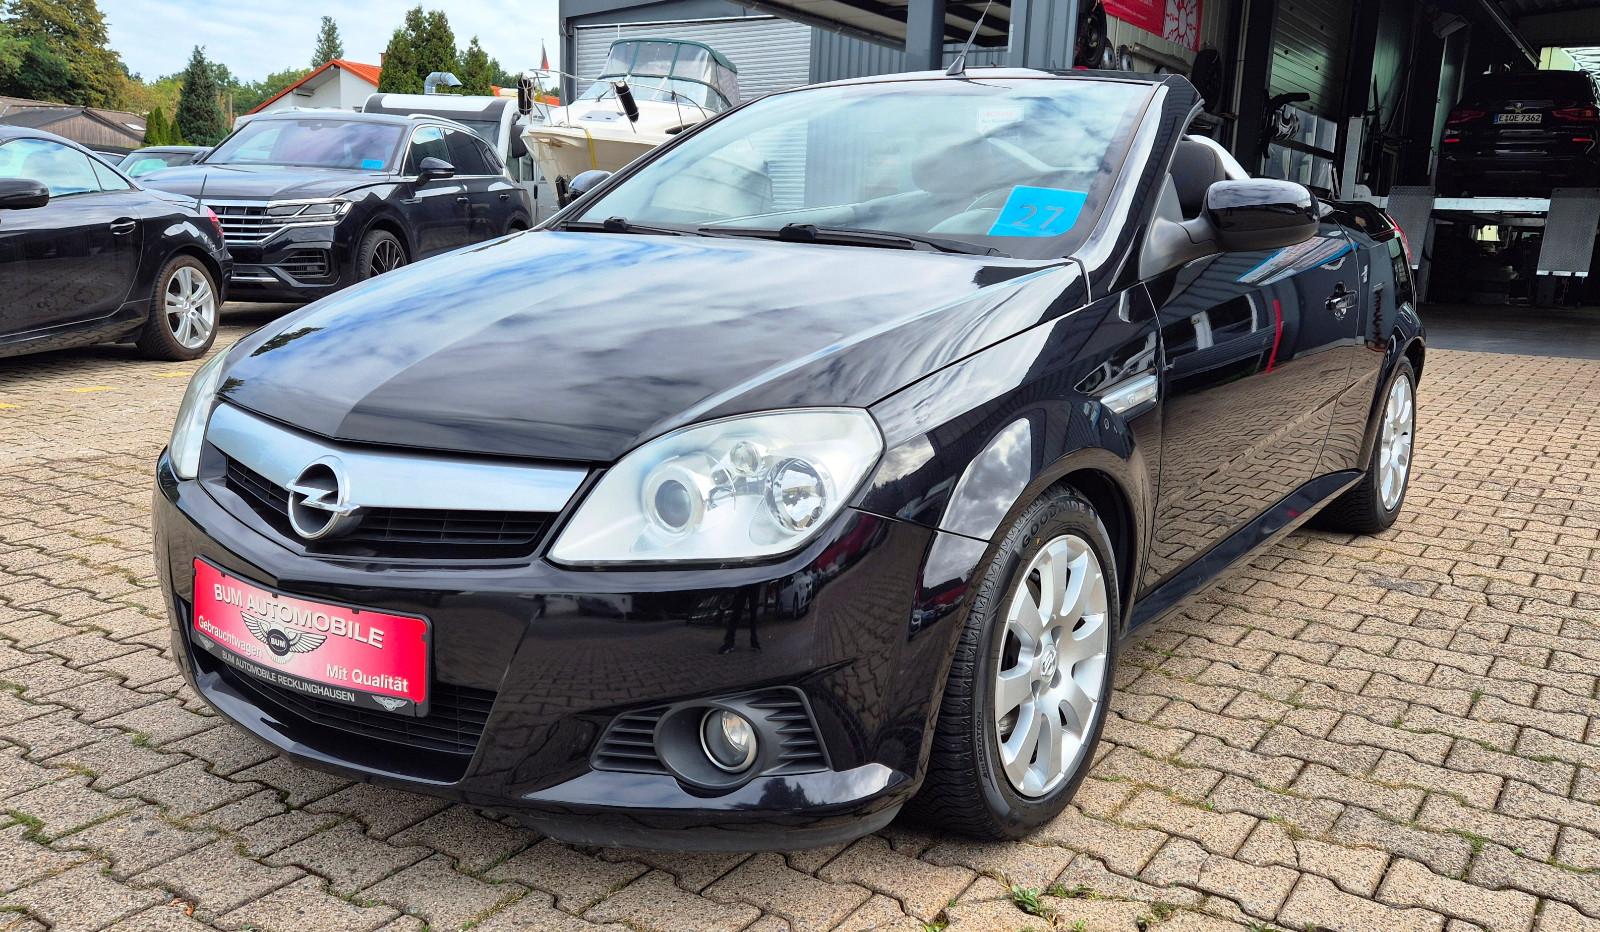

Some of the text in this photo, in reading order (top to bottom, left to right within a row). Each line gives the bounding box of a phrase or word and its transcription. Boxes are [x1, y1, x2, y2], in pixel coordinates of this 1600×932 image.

[1521, 114, 1541, 122] 7362
[1012, 204, 1065, 230] 27
[213, 583, 385, 649] BUM AUTOMOBILE
[198, 615, 263, 659] Gebrauchtwagen
[270, 637, 287, 648] BUM
[221, 649, 355, 703] BUM AUTOMOBILE RECKLINGHAUSEN
[326, 663, 409, 693] Mit Qualität
[976, 711, 985, 762] ROTATION
